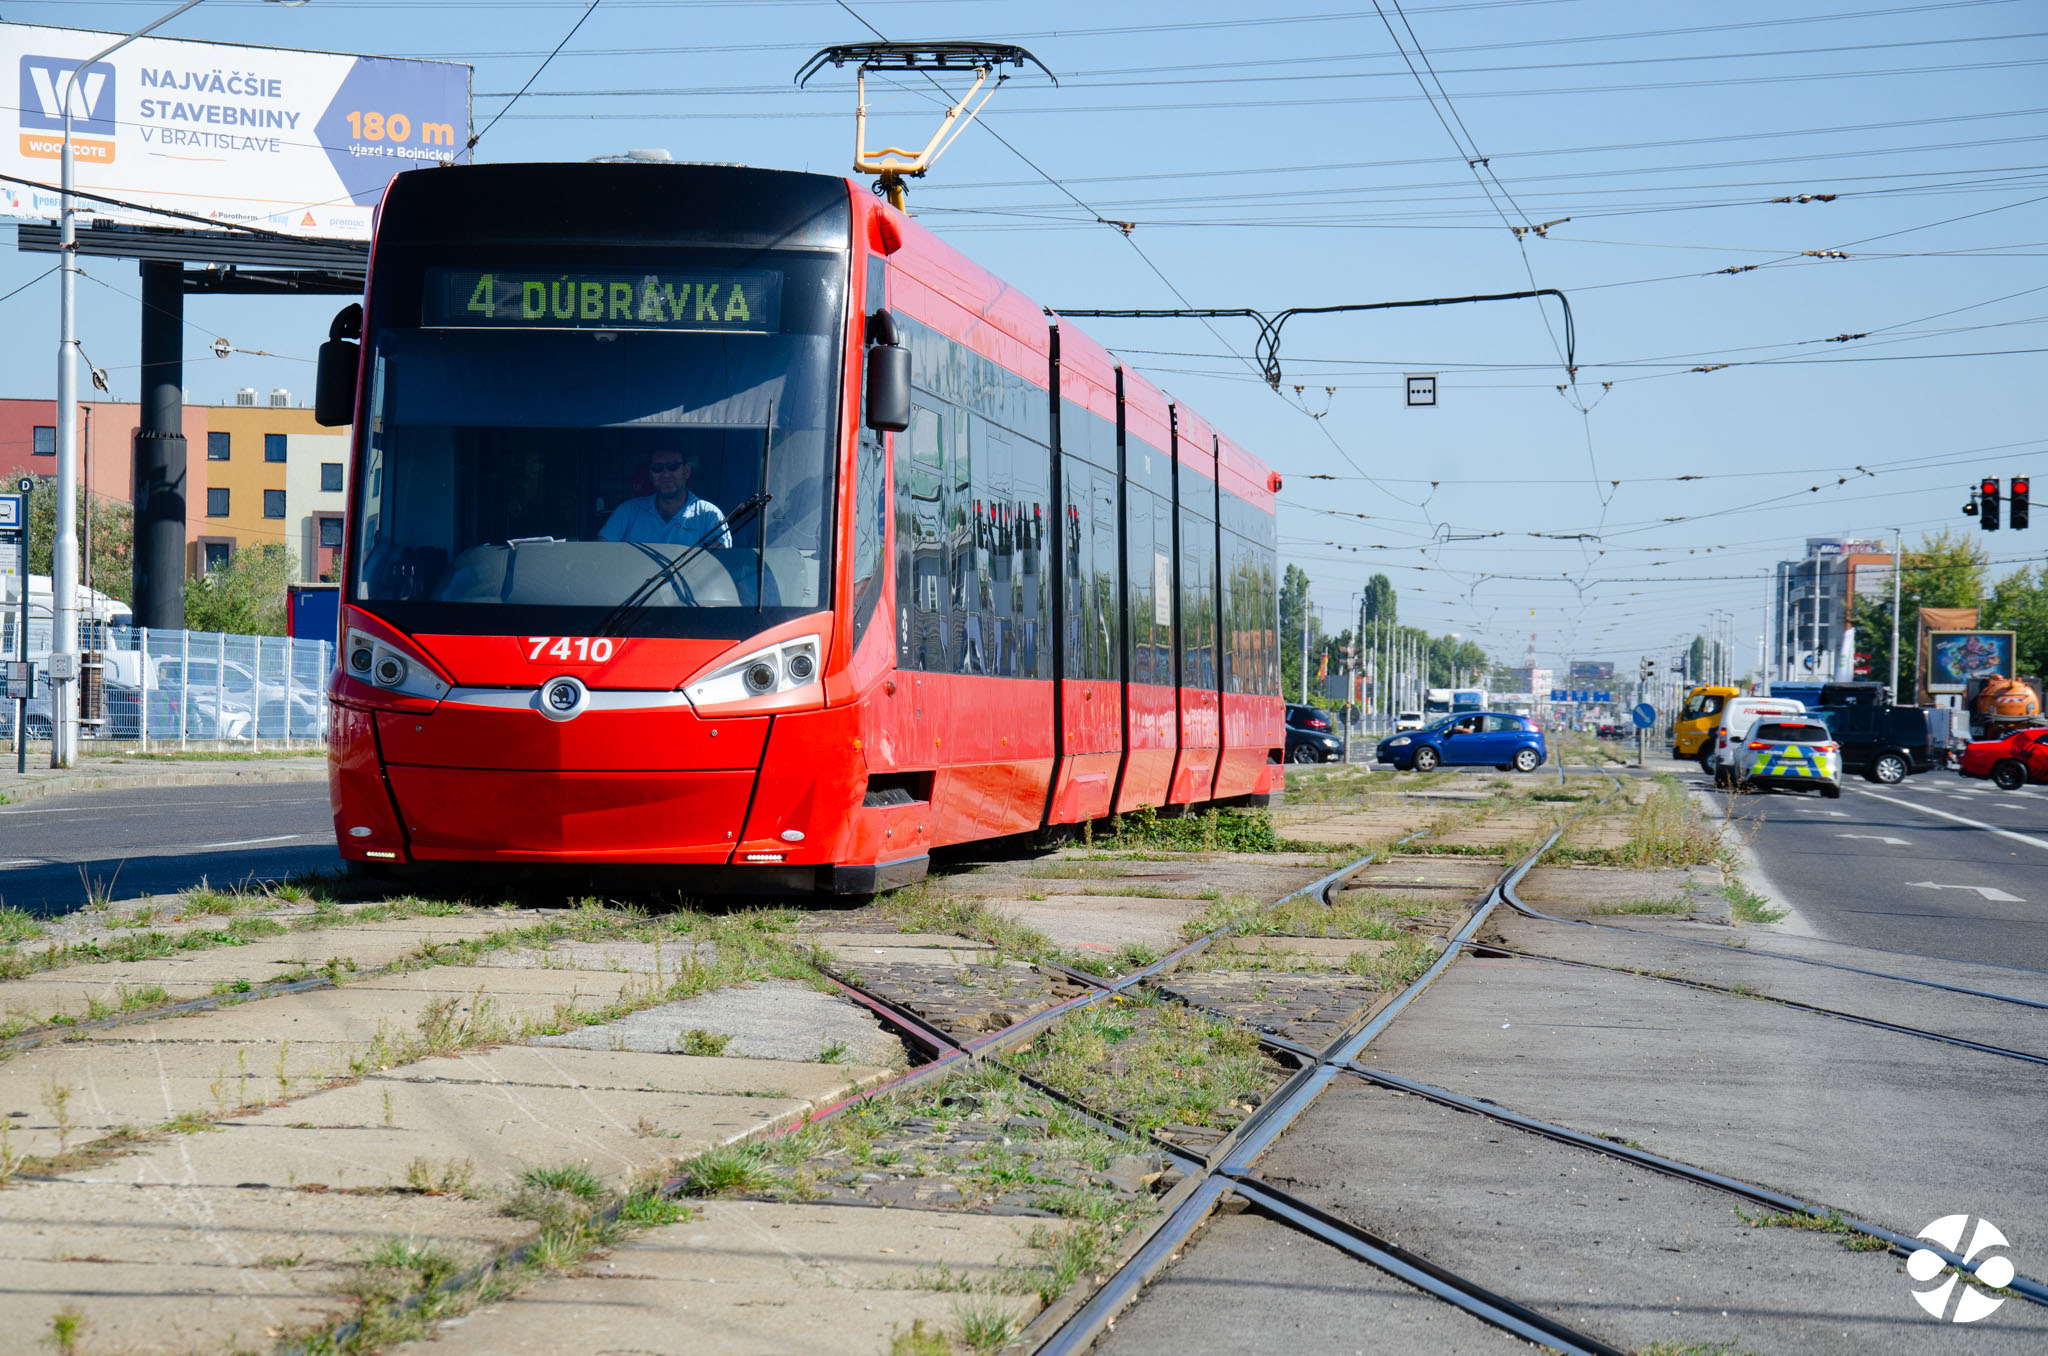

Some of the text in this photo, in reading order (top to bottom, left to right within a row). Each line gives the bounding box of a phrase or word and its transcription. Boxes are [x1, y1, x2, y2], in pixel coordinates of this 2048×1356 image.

[140, 67, 283, 98] NAJVÄČŠIE
[140, 98, 302, 130] STAVEBNINY
[140, 127, 281, 153] V BRATISLAVE
[346, 111, 455, 146] 180 m
[29, 140, 107, 158] WOOCOTE
[218, 211, 258, 221] Porotherm
[467, 273, 751, 321] 4 DÚBRAVKA
[22, 481, 30, 491] D
[528, 637, 613, 662] 7410
